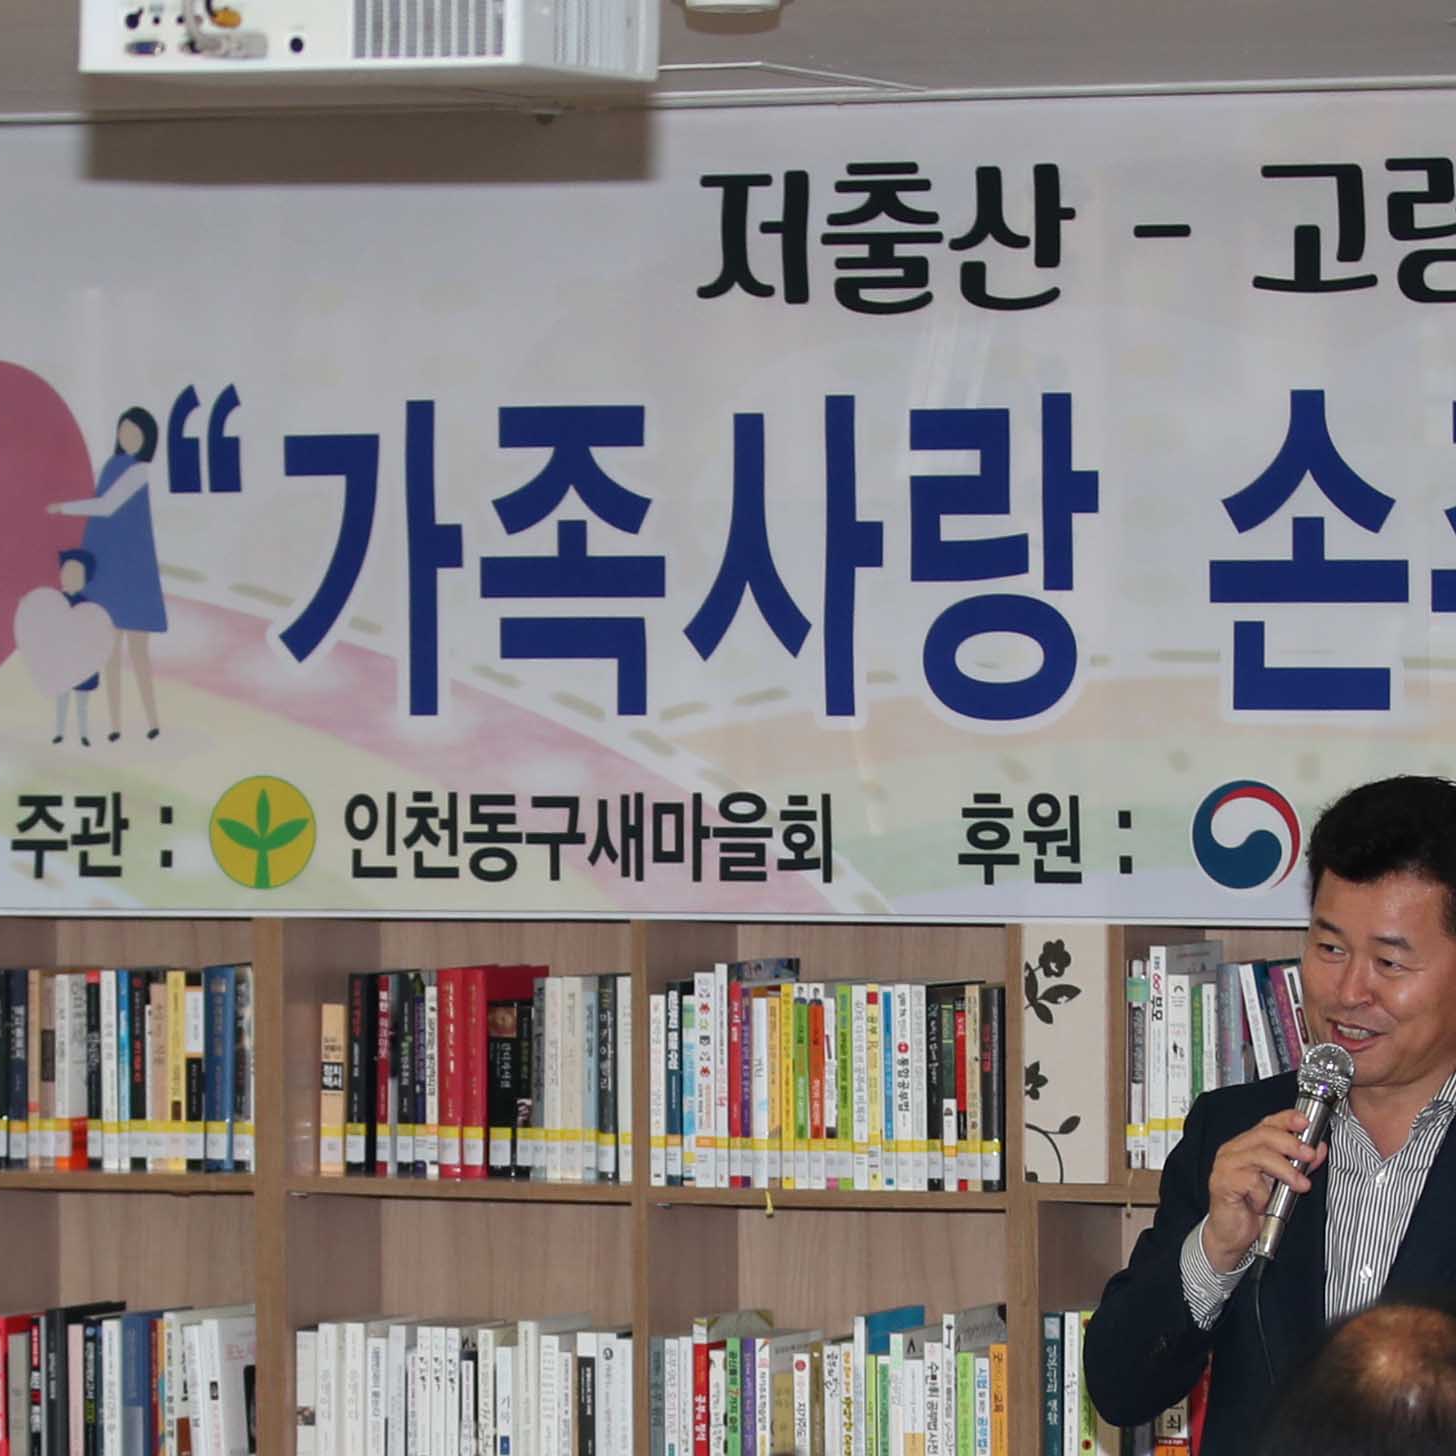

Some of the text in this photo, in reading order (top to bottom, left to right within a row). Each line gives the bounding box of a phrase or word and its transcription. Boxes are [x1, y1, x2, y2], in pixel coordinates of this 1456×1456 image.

[697, 161, 1076, 315] 저출산
[11, 792, 129, 879] 주관
[345, 791, 833, 883] 인천동구새마을회
[958, 793, 1082, 885] 후원
